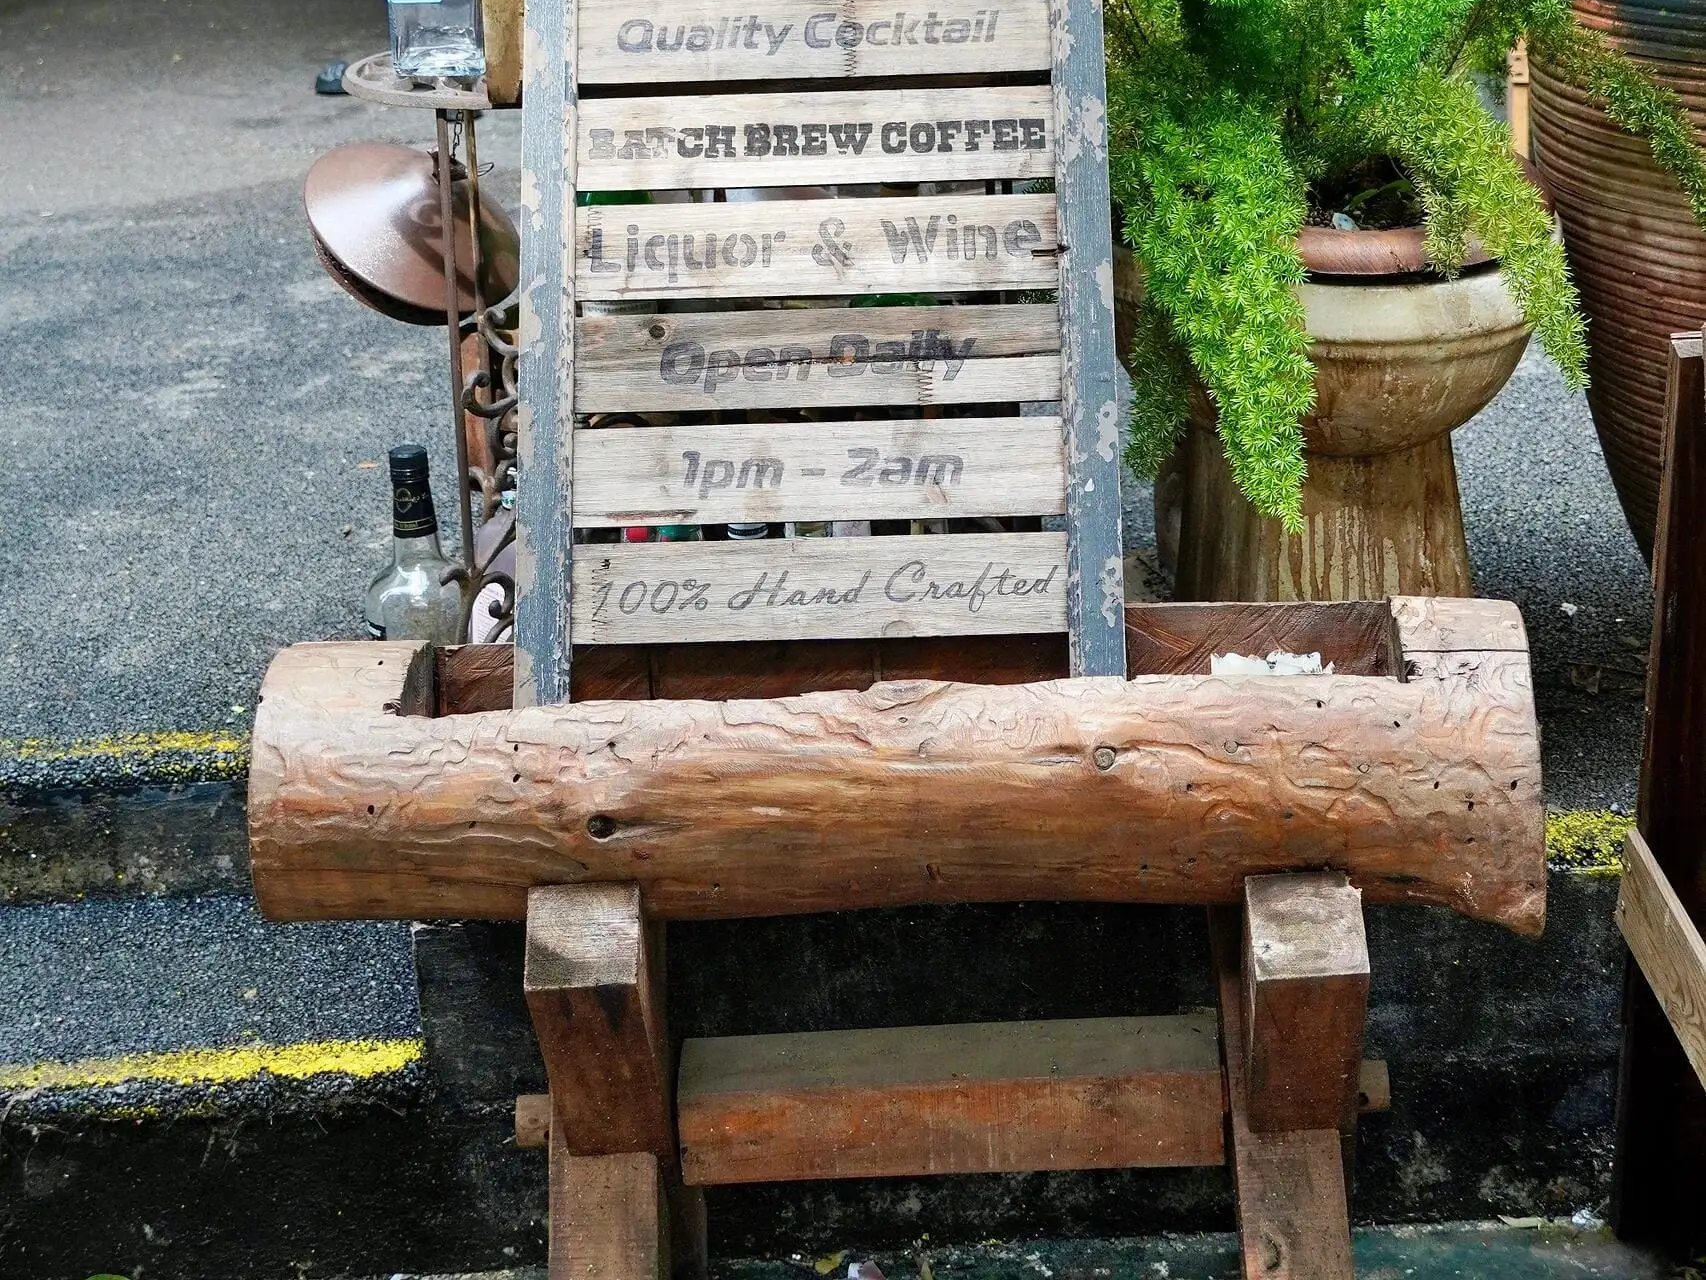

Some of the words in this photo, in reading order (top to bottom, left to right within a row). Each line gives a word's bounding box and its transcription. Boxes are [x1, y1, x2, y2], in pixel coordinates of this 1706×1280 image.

[617, 14, 795, 56] Quality
[804, 10, 1000, 49] Cocktail
[588, 124, 737, 160] BATCH
[743, 122, 874, 157] BREW
[880, 119, 1047, 155] COFFEE
[590, 223, 786, 283] Liquor
[811, 217, 854, 269] &
[882, 214, 1043, 265] Wine
[659, 341, 812, 394] Open
[826, 330, 977, 381] Daily
[682, 450, 785, 500] 1pm
[800, 468, 826, 477] -
[840, 447, 965, 487] 2am
[592, 578, 712, 623] 100%
[727, 570, 872, 610] Hand
[884, 560, 1060, 613] Crafted
